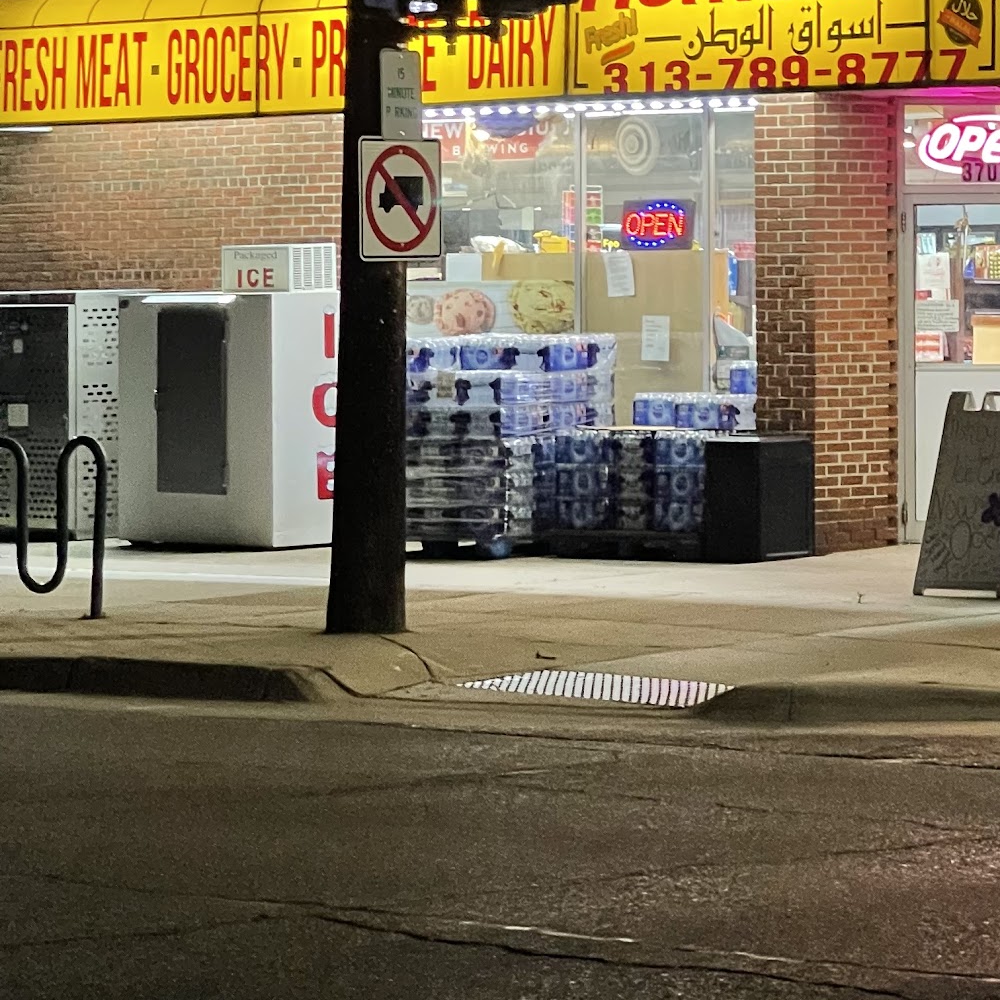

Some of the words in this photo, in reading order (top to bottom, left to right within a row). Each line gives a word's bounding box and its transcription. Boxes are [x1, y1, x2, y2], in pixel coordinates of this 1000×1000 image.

[683, 2, 773, 60] الوطن
[0, 36, 68, 112] RESH
[76, 32, 148, 108] MEAT
[167, 22, 289, 104] GROCERY
[468, 5, 556, 89] DAIRY
[603, 49, 967, 95] 313-789-8777
[386, 106, 417, 118] PRKING
[452, 143, 529, 156] BWING
[625, 212, 684, 236] OPEN
[234, 251, 278, 262] Packaged
[237, 267, 275, 288] ICE
